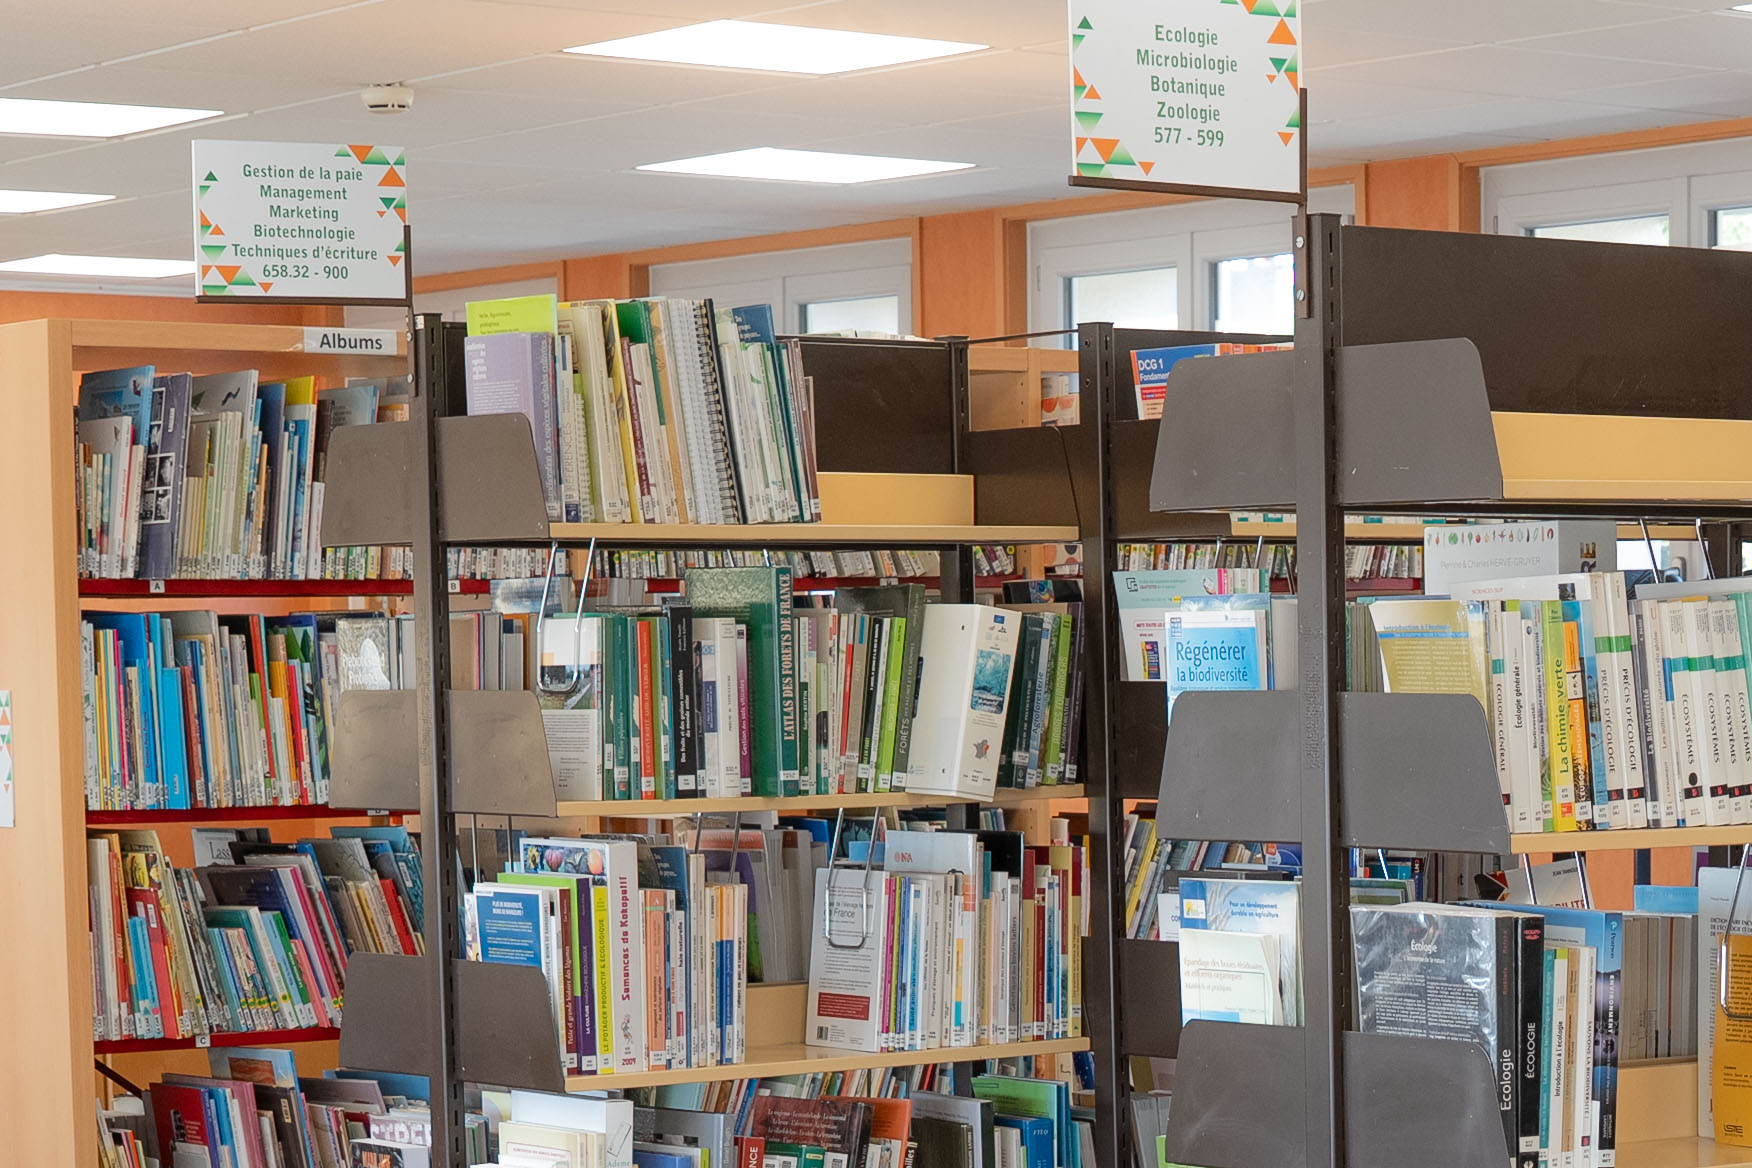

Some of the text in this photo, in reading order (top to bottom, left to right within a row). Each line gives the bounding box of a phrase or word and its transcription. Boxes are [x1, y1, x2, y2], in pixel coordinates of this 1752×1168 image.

[1155, 25, 1218, 47] Ecologie
[1137, 49, 1238, 75] Microbiologie
[1151, 75, 1225, 98] Botanique
[1157, 102, 1220, 124] Zoologie
[1154, 127, 1182, 144] 577
[1197, 129, 1224, 147] 599
[243, 164, 363, 182] Gestion de la paie
[260, 185, 347, 200] Management
[269, 205, 339, 222] Marketing
[254, 225, 355, 242] Biotechnologie
[232, 244, 378, 260] Techniques d'écriture
[263, 265, 309, 279] 658.32
[323, 266, 349, 279] 900
[320, 334, 383, 350] Albums
[1138, 358, 1164, 371] DCG 1
[154, 582, 161, 591] A
[779, 574, 792, 616] FRANCE
[780, 619, 793, 633] DE
[1175, 641, 1247, 664] Régénérer
[1175, 665, 1249, 682] la biodiversité
[781, 679, 795, 699] DES
[1032, 671, 1044, 734] Agroforesterie
[1514, 702, 1523, 729] Écologie
[782, 701, 796, 740] L'ATLAS
[1555, 659, 1569, 773] La chimie verte
[1601, 669, 1615, 774] PRÉCIS D'ÉCOLOGIE
[1622, 668, 1636, 772] PRÉCIS D'ÉCOLOGIE
[1708, 692, 1720, 764] ÉCOSYSTÈMES
[1724, 694, 1736, 764] ÉCOSYSTÈMES
[1738, 691, 1752, 761] ÉCOSYSTÈMES
[899, 724, 909, 754] FORÊTS
[1682, 694, 1695, 765] ÉCOSYSTÈMES
[1498, 730, 1506, 772] GÉNÉRALE
[598, 919, 606, 963] ÉCOLOGIQUE
[601, 1011, 609, 1042] POTAGER
[1526, 1022, 1536, 1078] ÉCOLOGIE
[1554, 1061, 1562, 1097] Introduction
